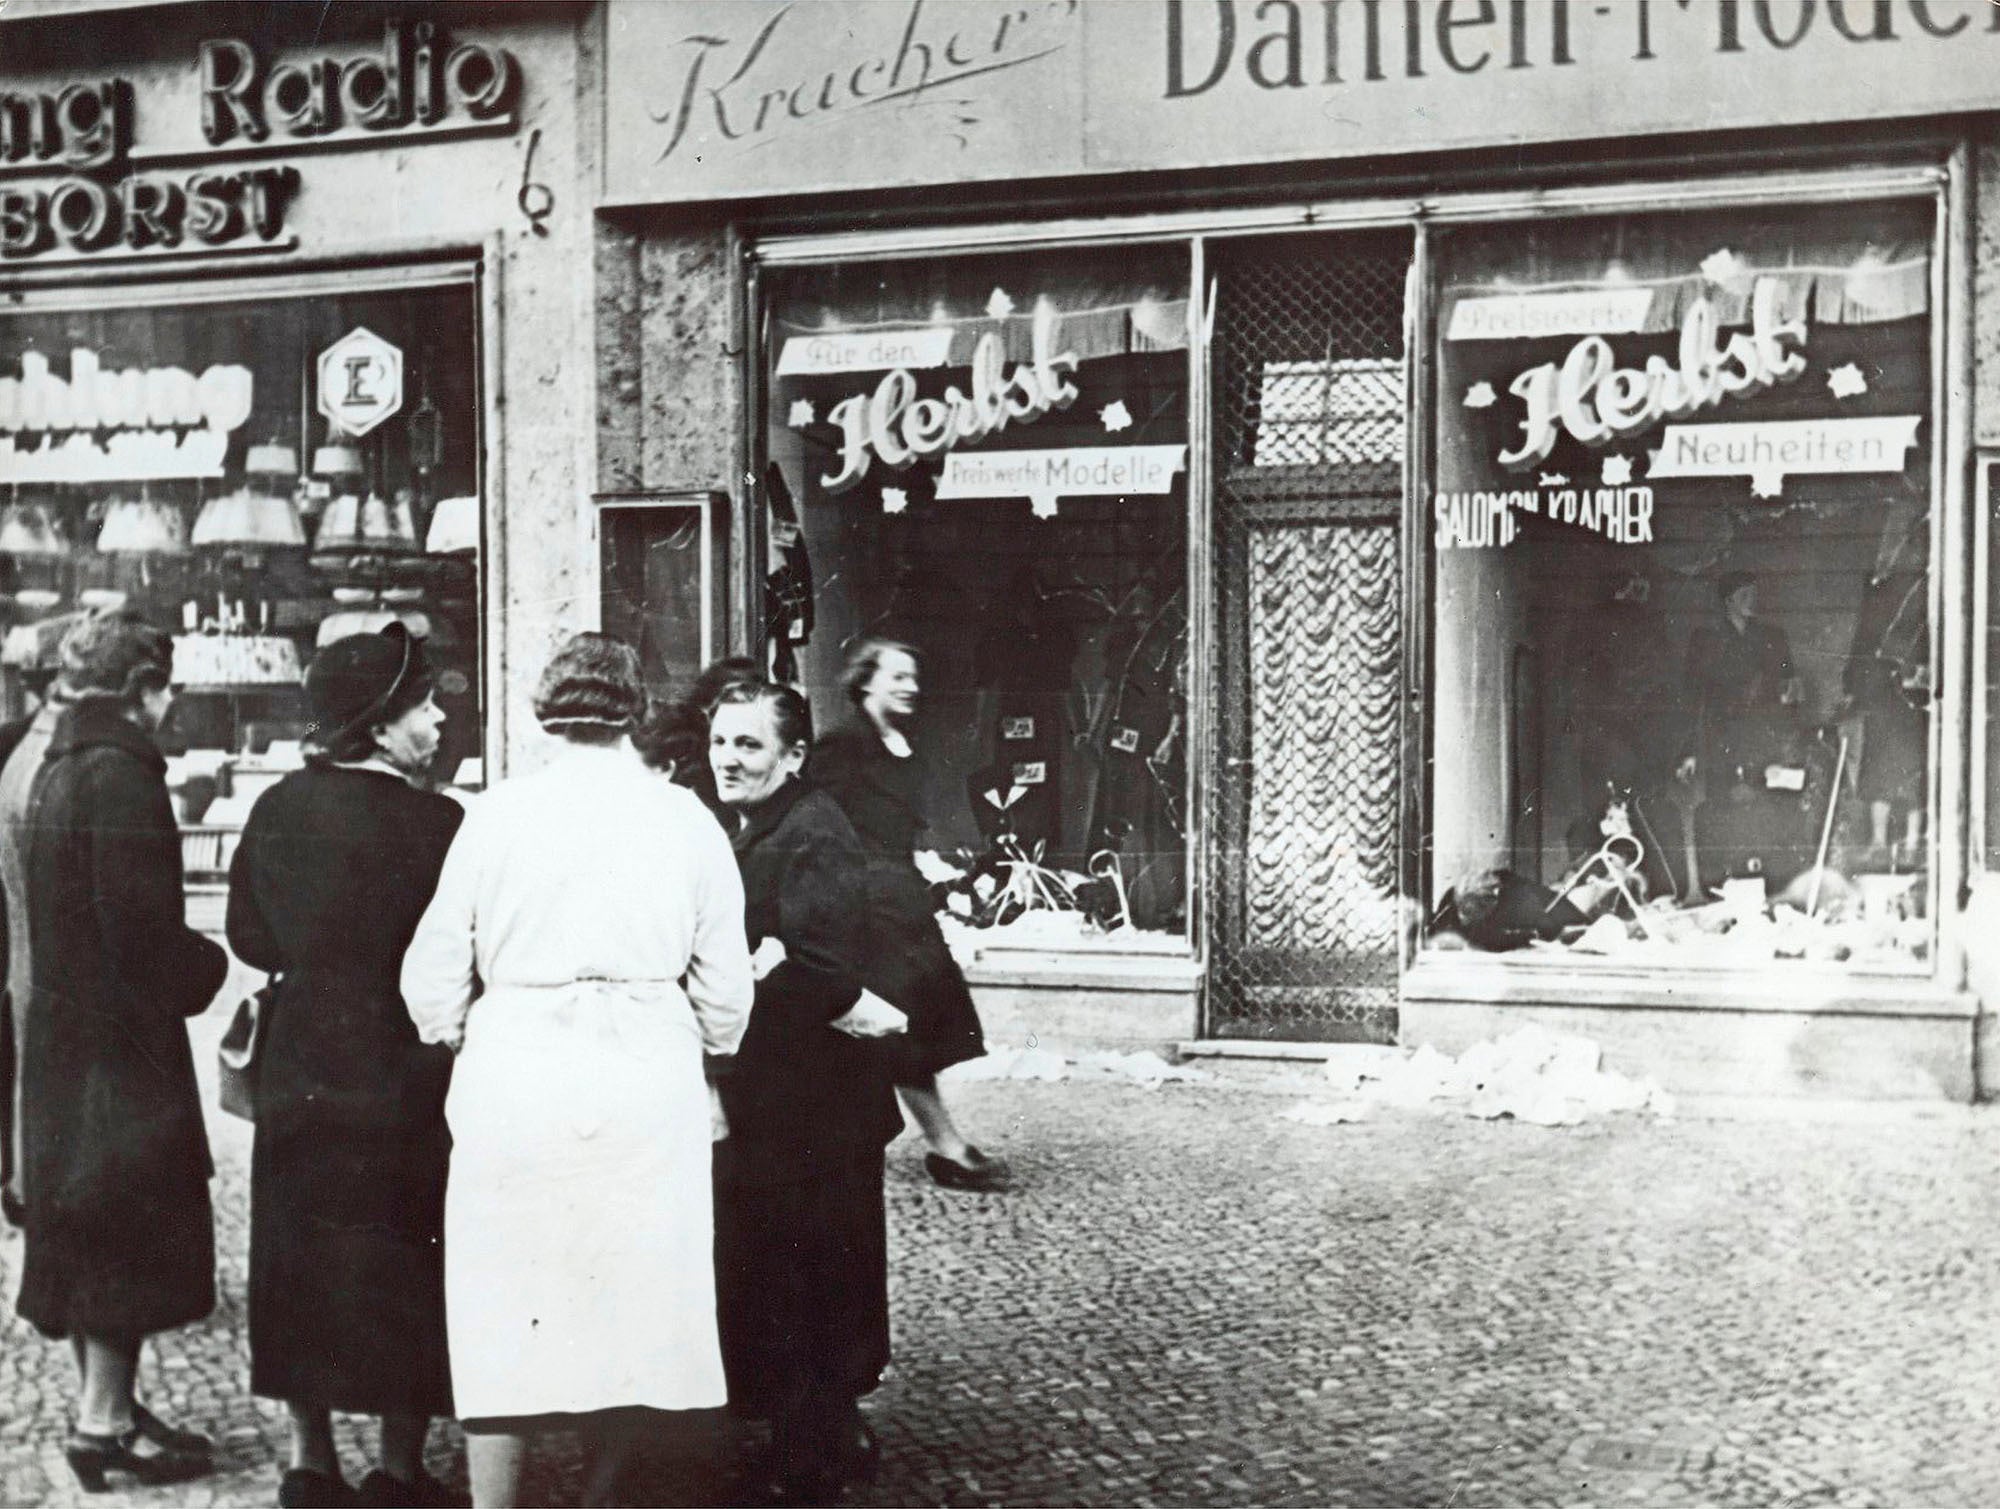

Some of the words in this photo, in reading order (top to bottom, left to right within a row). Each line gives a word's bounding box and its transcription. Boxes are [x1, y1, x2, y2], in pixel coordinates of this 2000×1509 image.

[200, 20, 520, 147] Radio
[868, 340, 918, 364] den
[1498, 277, 1807, 473] Herbst
[821, 294, 1079, 490] Herbst
[1045, 455, 1163, 486] Modelle
[1676, 430, 1884, 465] Neuheiten
[1434, 490, 1539, 549] SALOM
